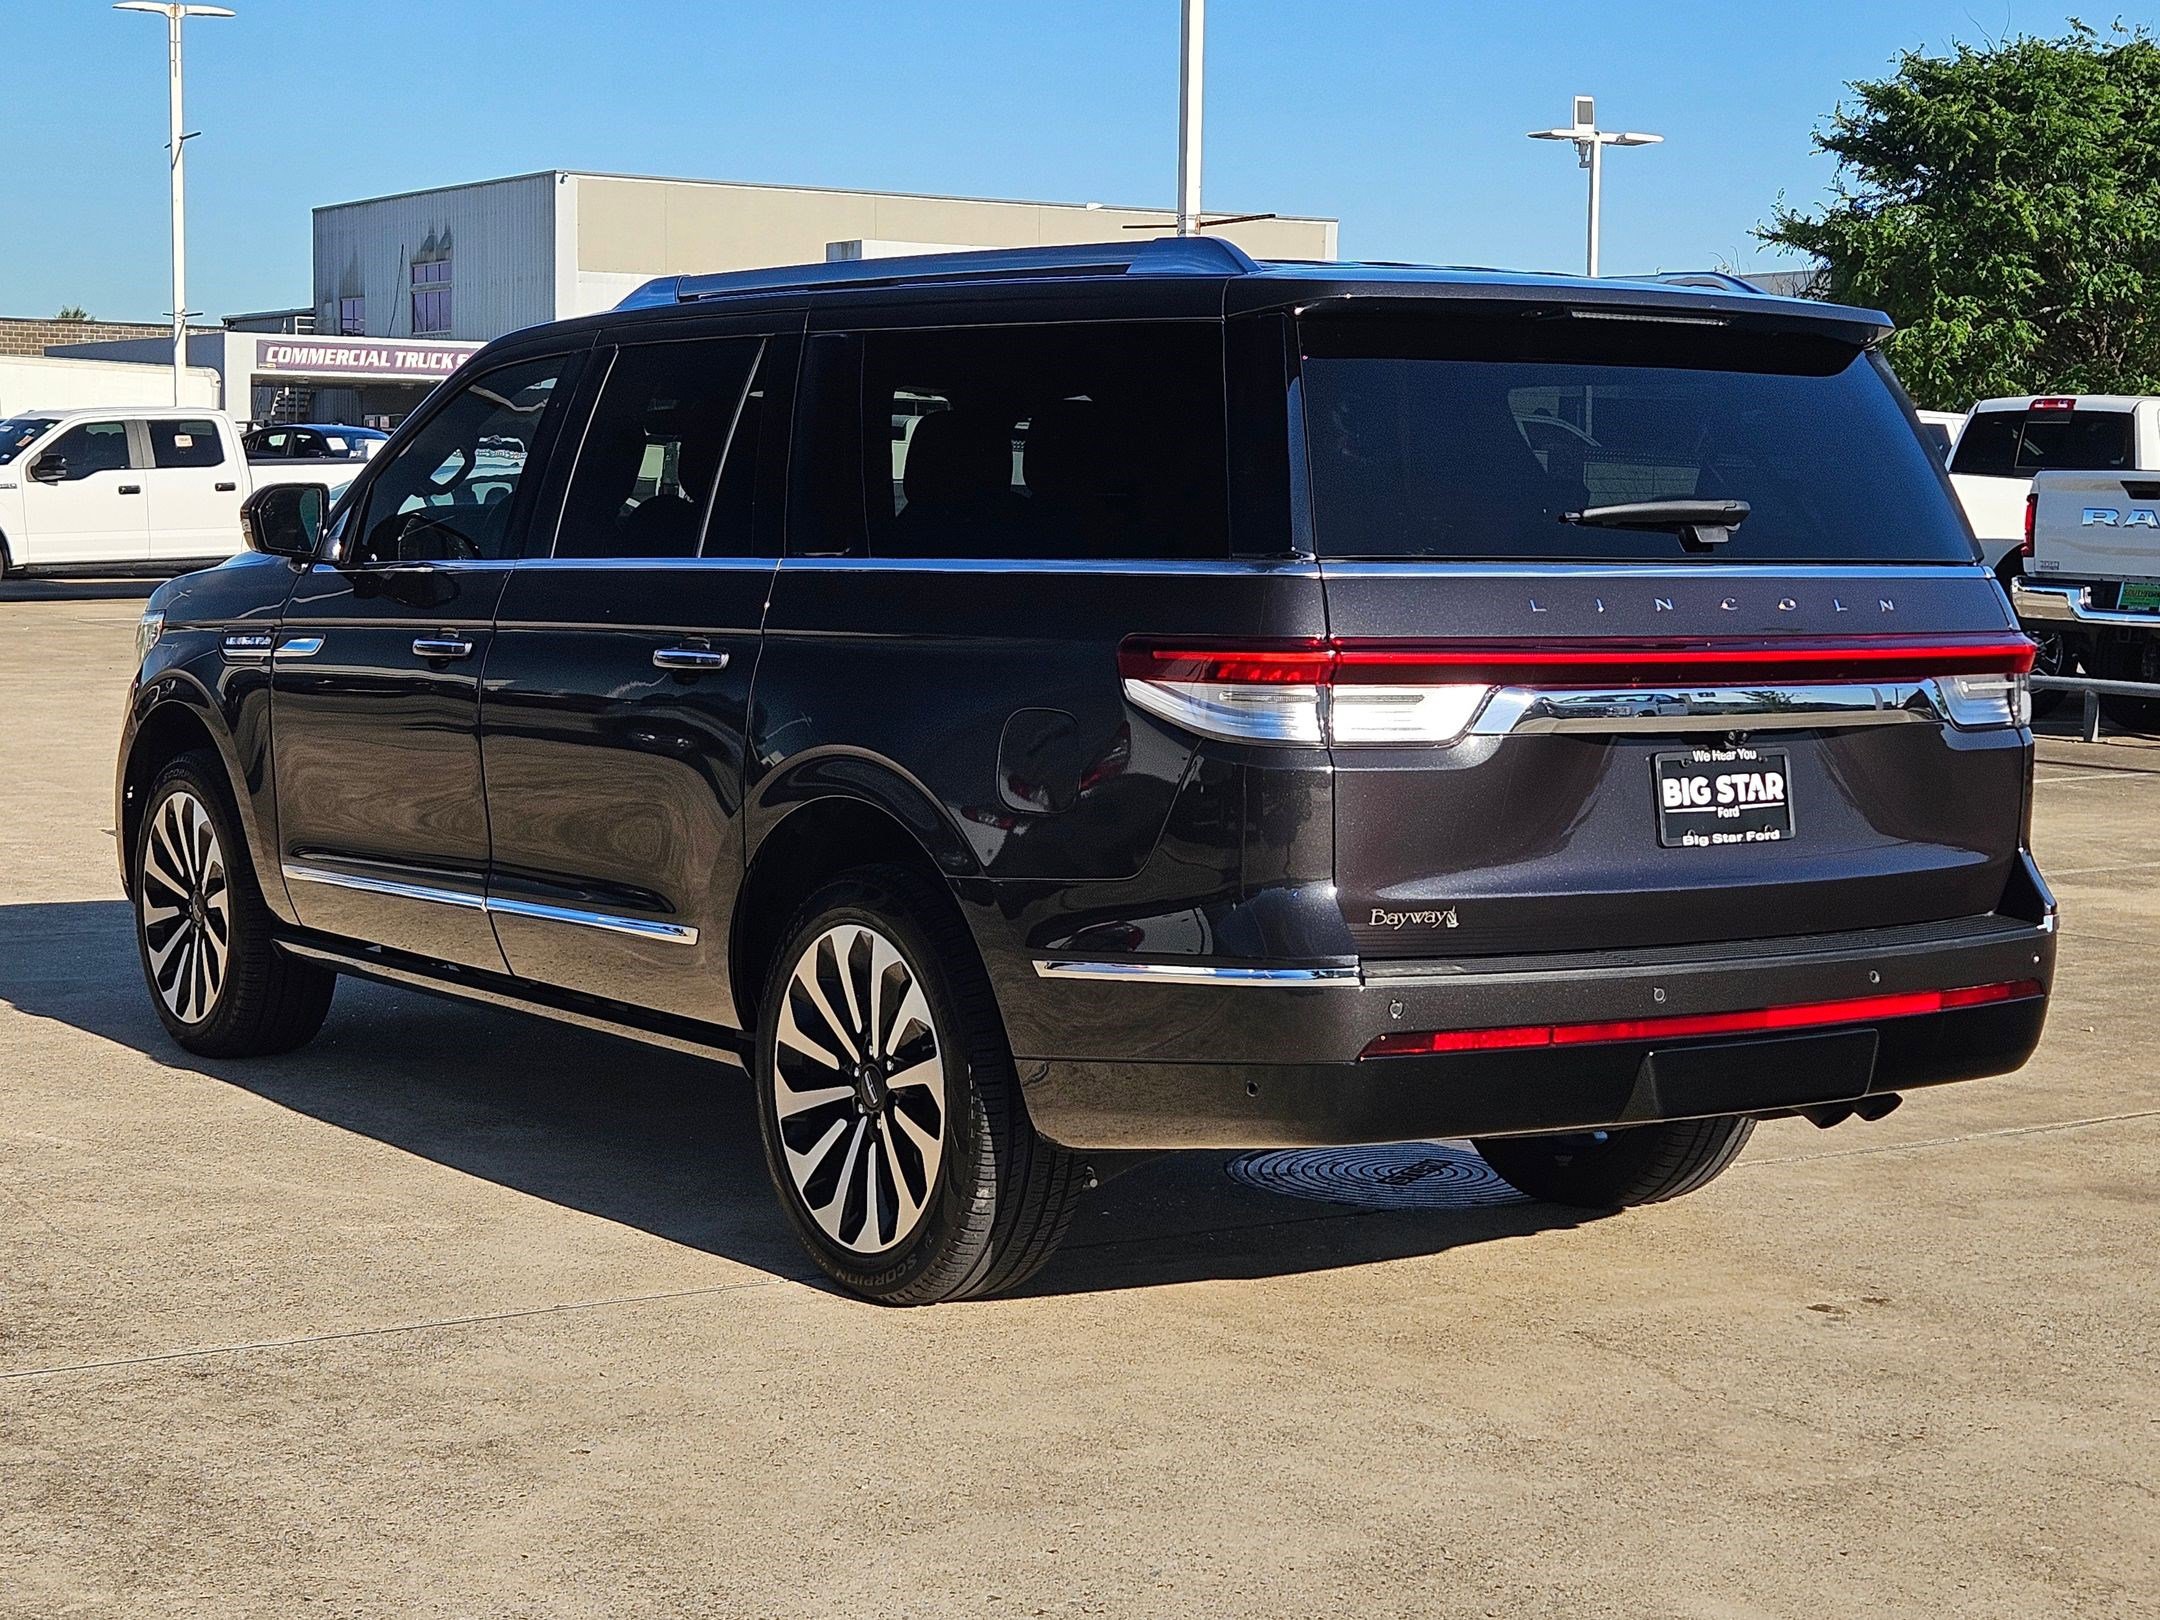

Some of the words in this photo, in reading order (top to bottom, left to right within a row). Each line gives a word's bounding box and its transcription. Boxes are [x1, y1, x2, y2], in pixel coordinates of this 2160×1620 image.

[266, 346, 391, 367] COMMERCIAL
[394, 351, 455, 369] TRUCK
[1529, 597, 1895, 612] LINCOLN
[1692, 750, 1711, 762] We
[1712, 750, 1736, 762] Hear
[1736, 748, 1757, 760] You
[1662, 776, 1712, 807] BIG
[1715, 772, 1785, 803] STAR
[1717, 805, 1740, 818] Ford
[1682, 834, 1710, 847] Big
[1712, 833, 1743, 844] Star
[1746, 829, 1781, 842] Ford
[1368, 908, 1448, 930] Bayway
[835, 1252, 918, 1288] SCORPION
